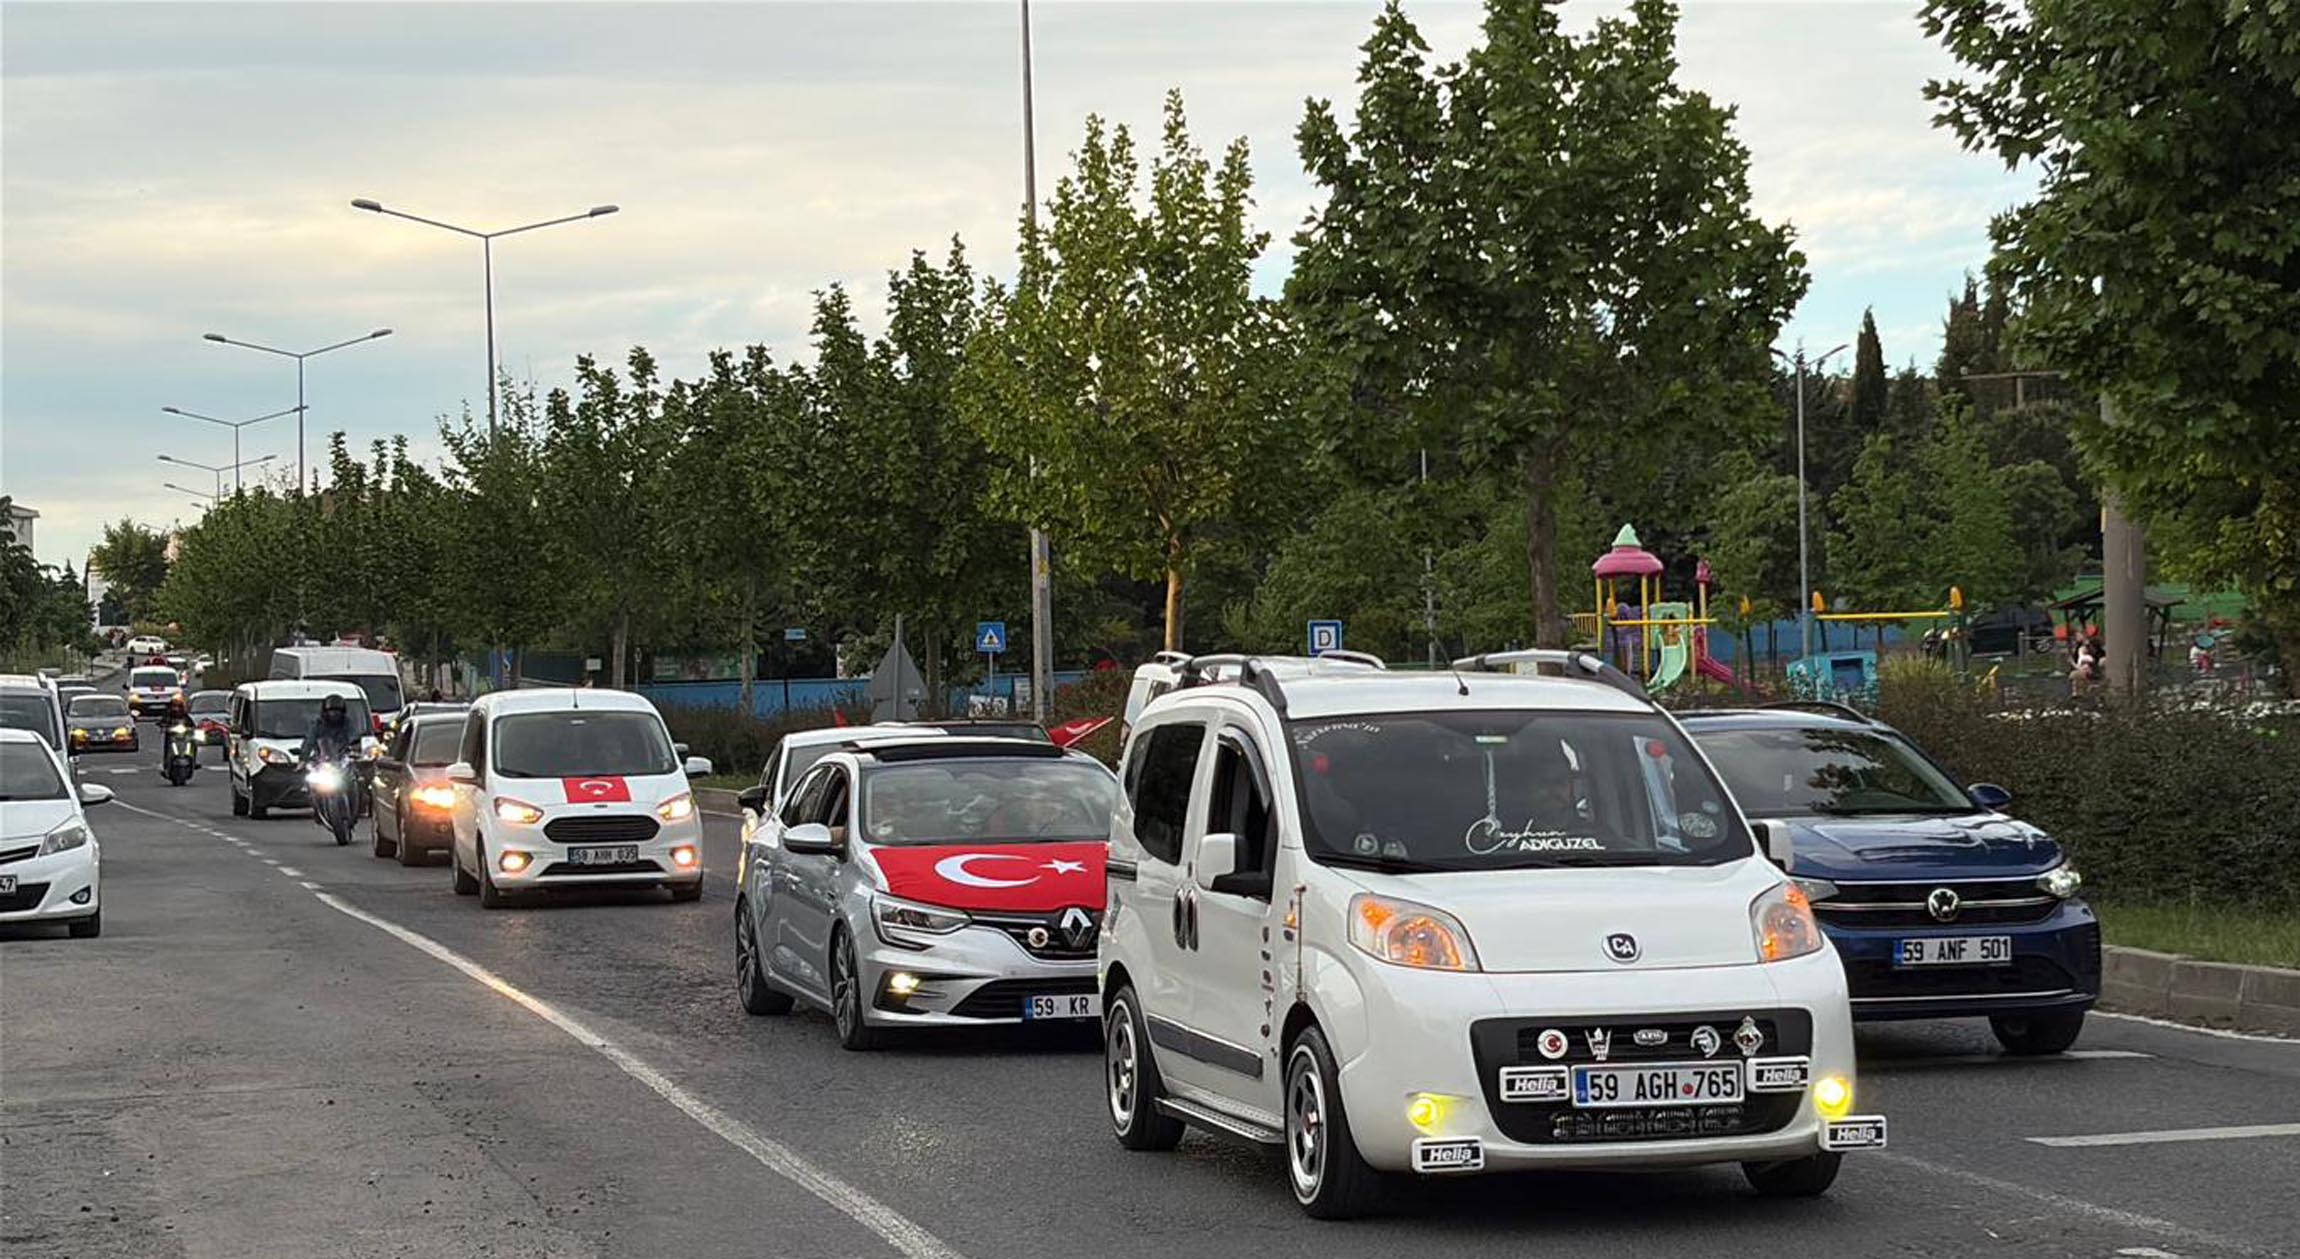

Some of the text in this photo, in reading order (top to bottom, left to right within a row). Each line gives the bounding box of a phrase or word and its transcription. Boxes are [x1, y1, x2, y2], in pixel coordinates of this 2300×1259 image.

[1318, 630, 1332, 647] D
[1611, 937, 1635, 955] CA
[1903, 938, 2010, 962] 59 ANF 501
[1034, 996, 1090, 1016] 59 KR
[1762, 1067, 1802, 1082] Hella
[1514, 1077, 1558, 1092] Hella
[1589, 1070, 1736, 1101] 59 AGH 765
[1836, 1127, 1876, 1141] Hella
[1429, 1146, 1472, 1161] Hella
